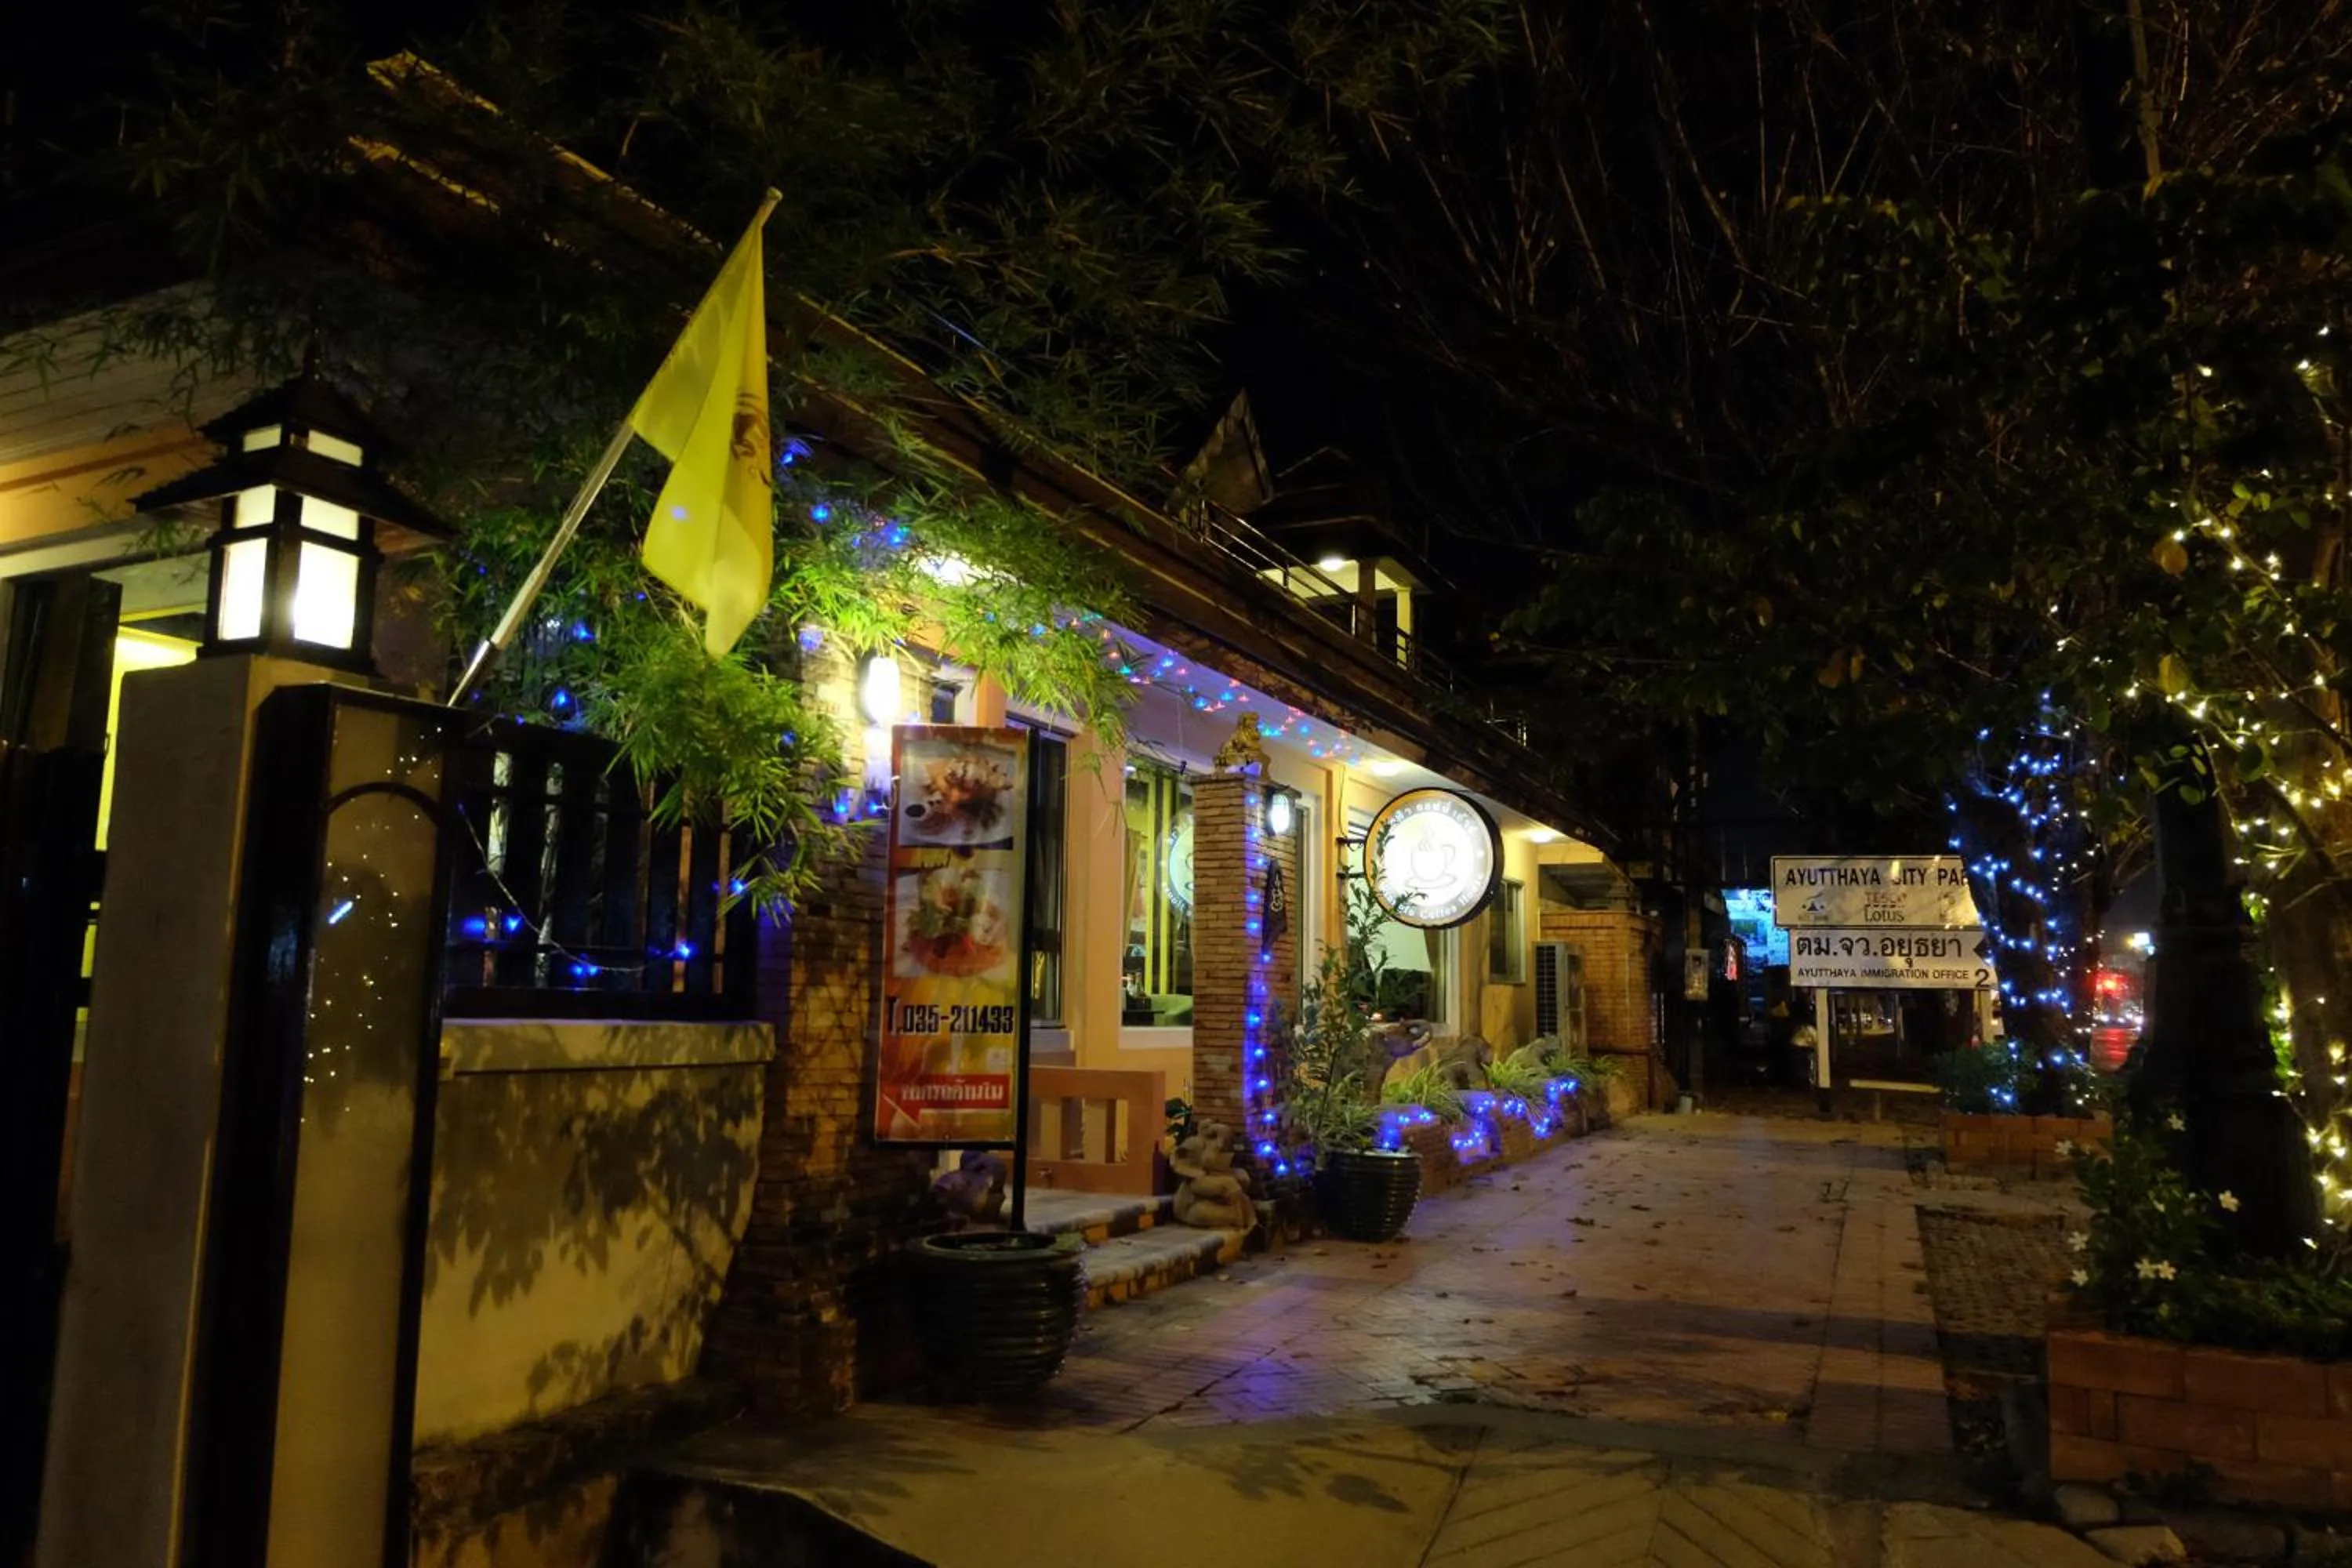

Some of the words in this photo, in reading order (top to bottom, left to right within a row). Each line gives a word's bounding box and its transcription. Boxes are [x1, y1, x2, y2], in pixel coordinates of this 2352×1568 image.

[1785, 868, 1881, 886] AYUTTHAYA
[1796, 937, 1962, 967] ตม.จว.อยุธยา
[1798, 967, 1857, 978] AYUTTHAYA
[1860, 968, 1929, 979] IMMIGRATION
[1932, 969, 1969, 979] OFFICE
[1974, 967, 1990, 988] 2
